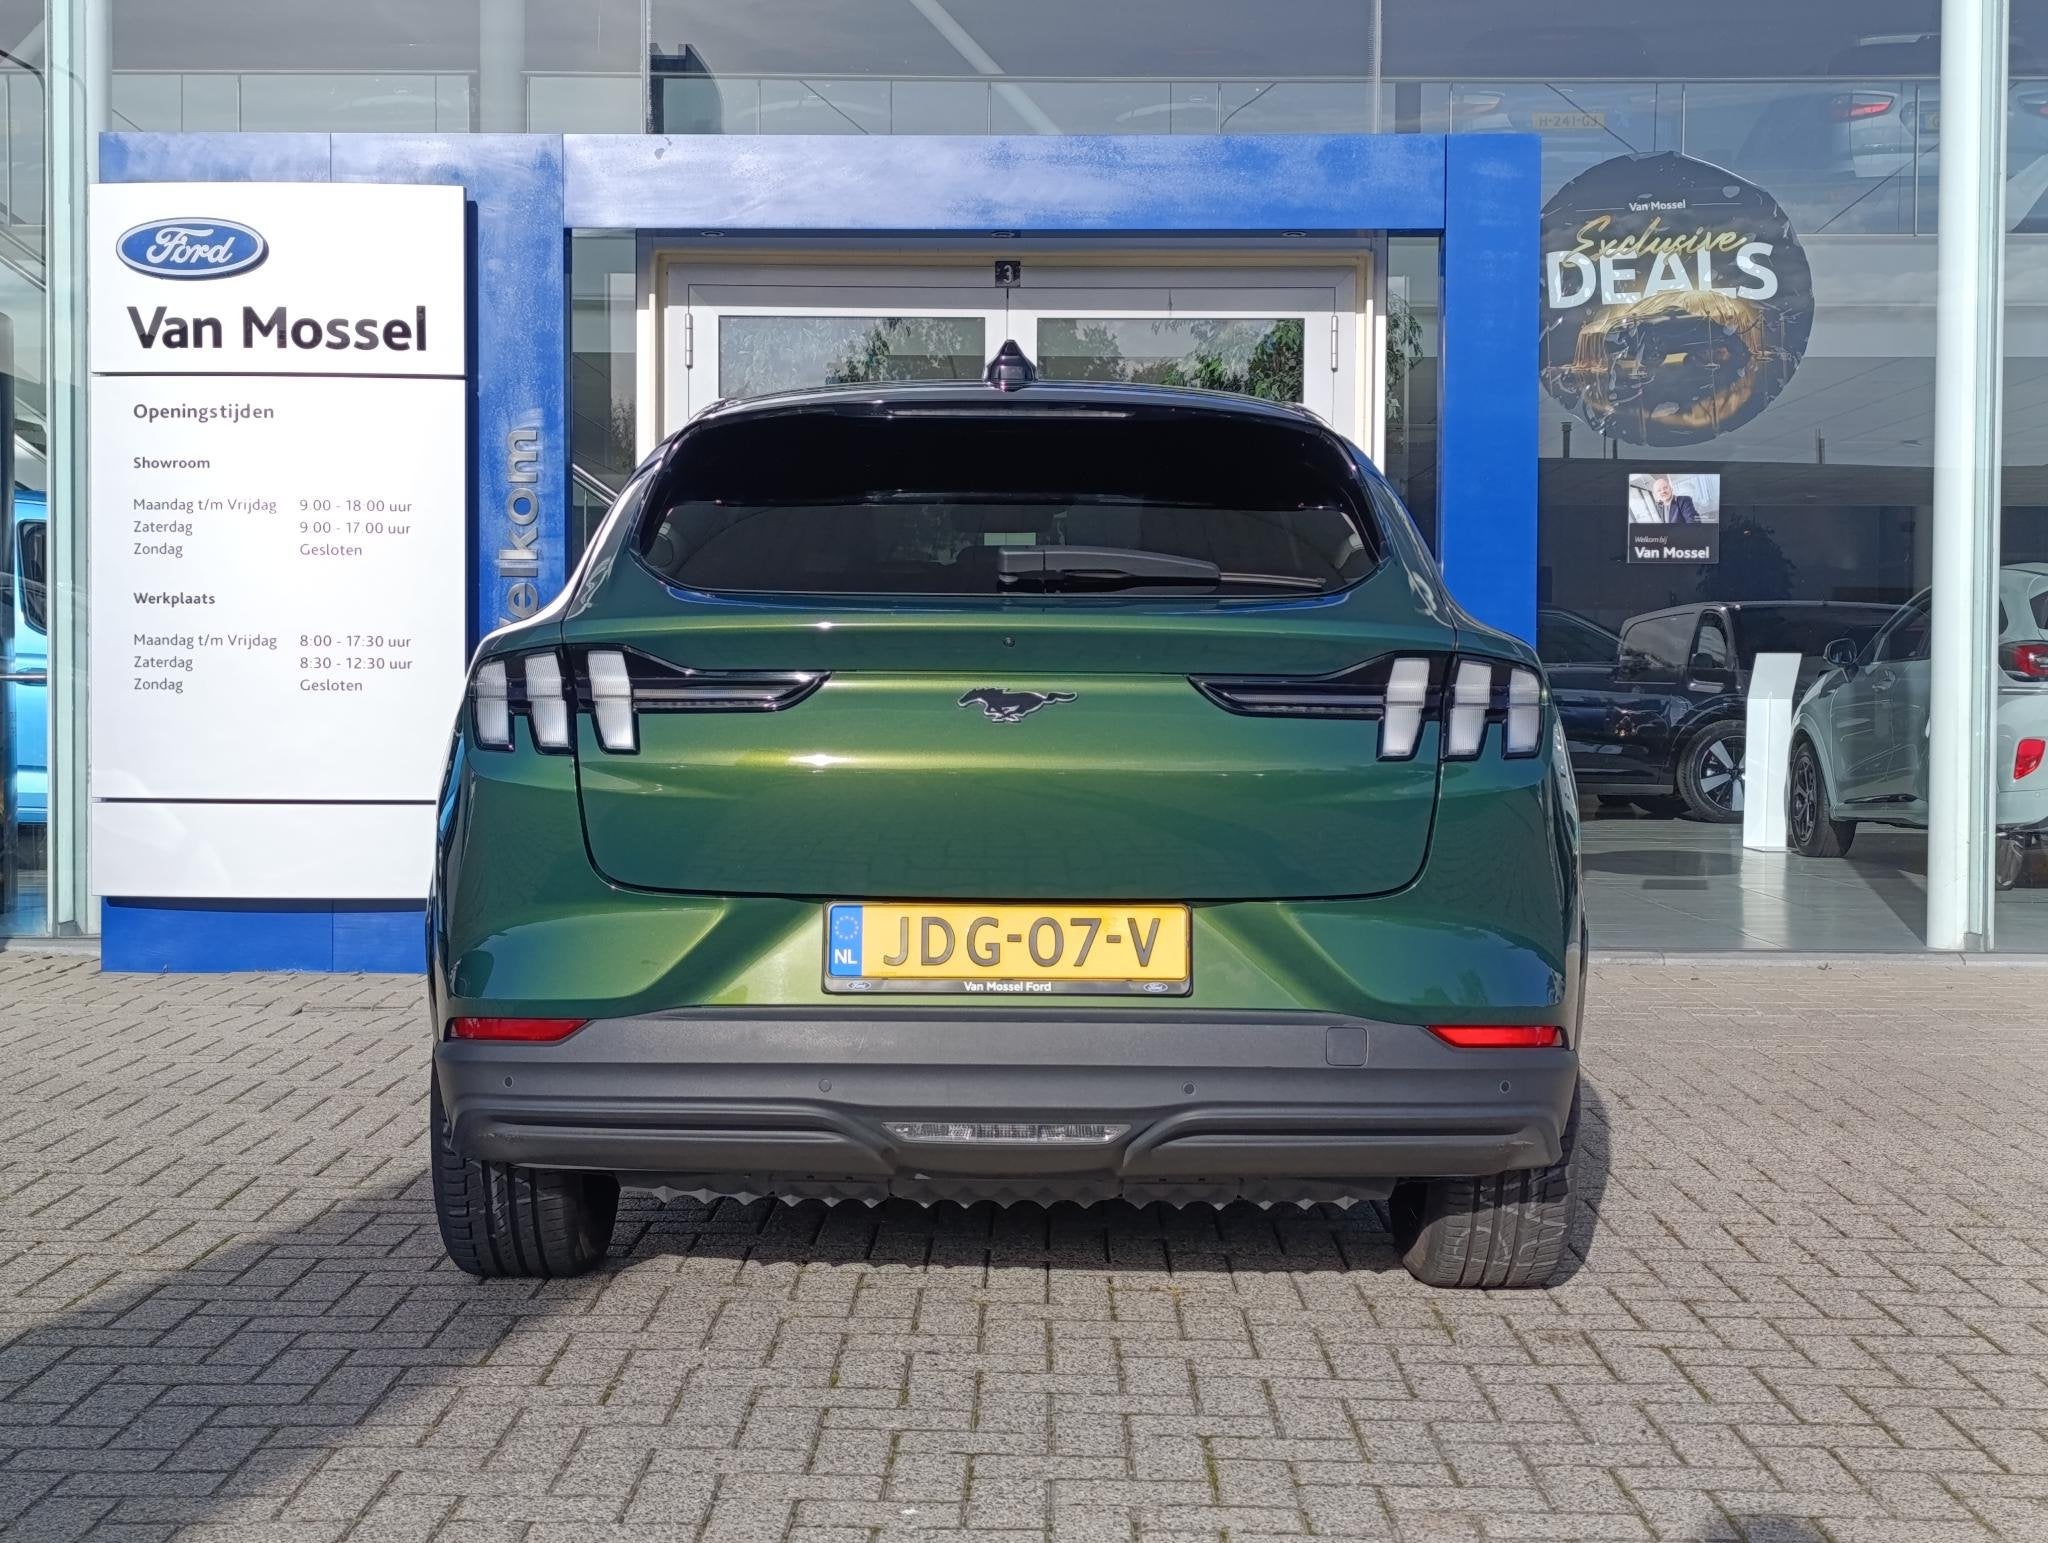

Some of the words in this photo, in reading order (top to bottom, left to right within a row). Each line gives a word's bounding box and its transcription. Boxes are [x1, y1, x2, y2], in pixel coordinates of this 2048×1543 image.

[1628, 201, 1649, 212] Van
[1651, 199, 1686, 211] Mossel
[146, 226, 236, 264] Ford
[1562, 214, 1748, 269] Exclusive
[1003, 264, 1012, 284] 3
[1545, 241, 1779, 309] DEALS
[126, 305, 223, 350] Van
[242, 305, 427, 352] Mossel
[133, 404, 275, 423] Openingstijden
[132, 456, 211, 470] Showroom
[133, 498, 194, 515] Maandag
[198, 498, 223, 512] t/m
[227, 499, 277, 516] Vrijdag
[389, 503, 413, 512] uur
[133, 520, 193, 536] Zaterdag
[388, 525, 412, 535] uur
[499, 427, 539, 626] elkom
[133, 543, 183, 559] Zondag
[299, 543, 363, 557] Gesloten
[1635, 547, 1660, 559] Van
[1663, 546, 1710, 559] Mossel
[133, 592, 216, 608] Werkplaats
[133, 633, 194, 650] Maandag
[198, 634, 224, 647] t/m
[227, 635, 278, 651] Vrijdag
[299, 634, 333, 648] 8:00
[346, 635, 385, 648] 17:30
[388, 638, 412, 648] uur
[133, 656, 194, 673] Zaterdag
[299, 656, 332, 669] 8:30
[346, 657, 386, 670] 12:30
[389, 660, 413, 670] uur
[133, 678, 184, 694] Zondag
[299, 679, 363, 692] Gesloten
[883, 916, 1161, 967] JDG-07-V
[834, 949, 858, 965] NL
[963, 981, 984, 991] Van
[986, 981, 1024, 992] Mossel
[1025, 982, 1052, 992] Ford
